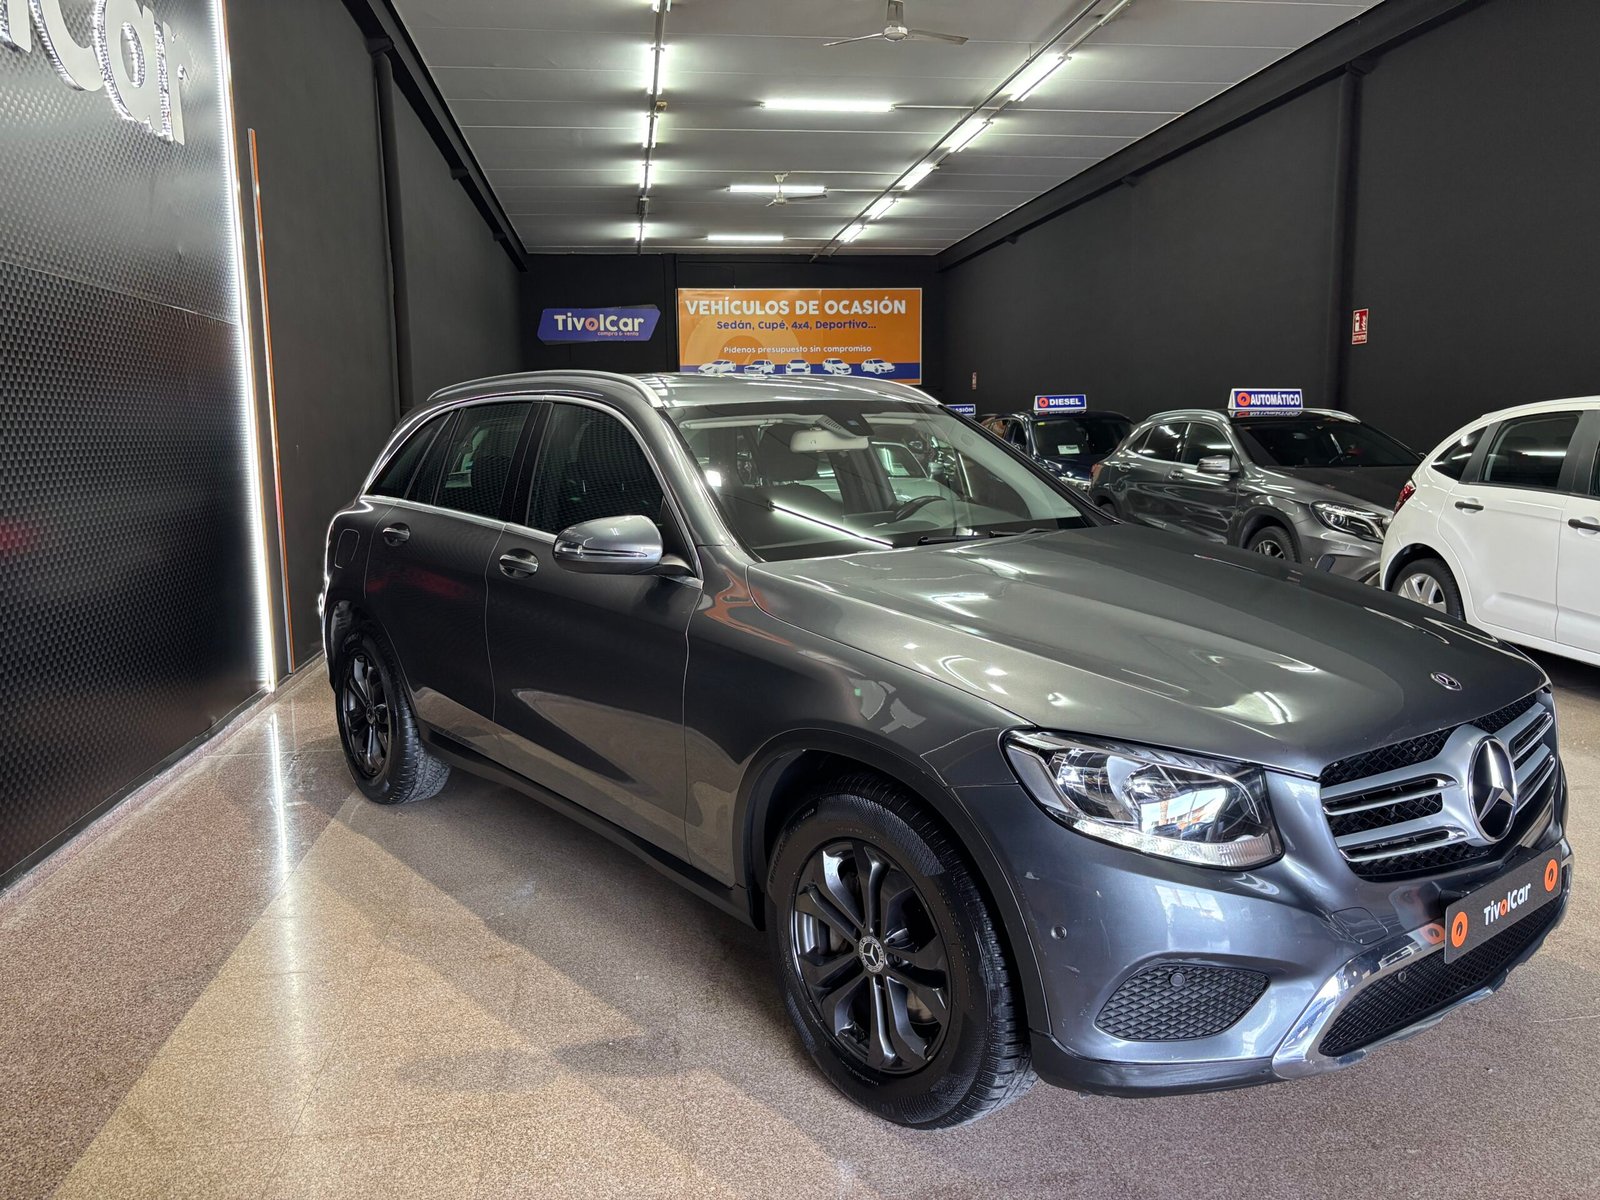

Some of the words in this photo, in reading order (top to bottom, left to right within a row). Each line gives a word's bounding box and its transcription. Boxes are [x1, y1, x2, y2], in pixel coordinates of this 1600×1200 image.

[685, 296, 790, 316] VEHÍCULOS
[795, 300, 820, 315] DE
[824, 296, 906, 315] OCASIÓN
[553, 312, 645, 331] TivolCar
[716, 320, 755, 331] Sedán,
[758, 320, 789, 331] Cupé,
[791, 321, 813, 331] 4x4,
[757, 346, 808, 355] presupuesto
[809, 345, 821, 353] sin
[823, 346, 873, 354] compromiso
[1049, 398, 1082, 406] DIESEL
[1250, 392, 1300, 406] AUTOMÁTICO
[1483, 883, 1531, 926] TivolCar
